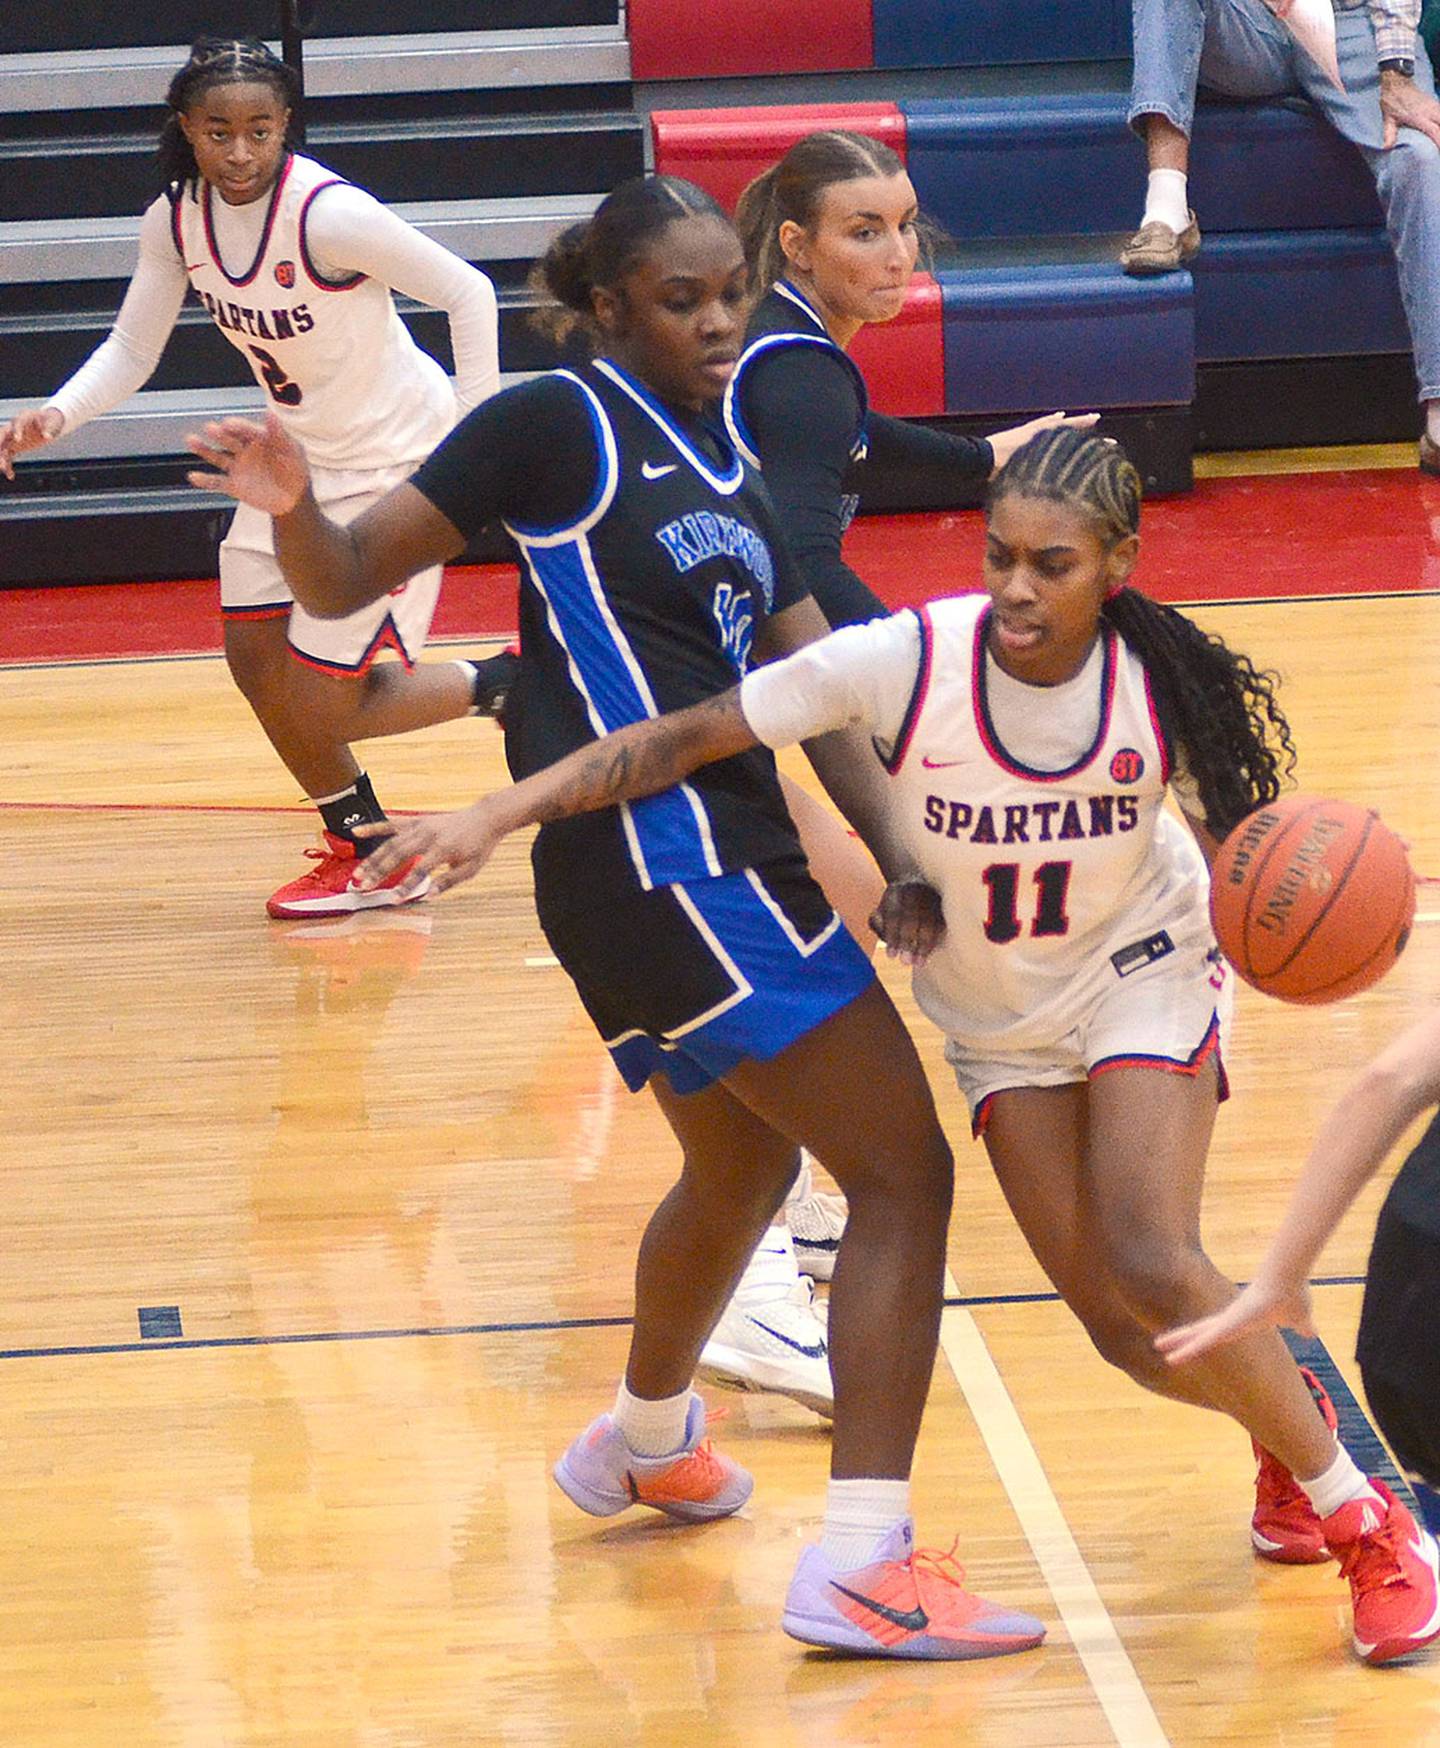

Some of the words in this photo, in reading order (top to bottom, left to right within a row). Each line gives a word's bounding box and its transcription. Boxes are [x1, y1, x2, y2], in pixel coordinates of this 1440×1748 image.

[195, 290, 315, 340] PARTANS
[247, 343, 303, 406] 2
[923, 795, 1139, 844] SPARTANS
[981, 860, 1073, 944] 11
